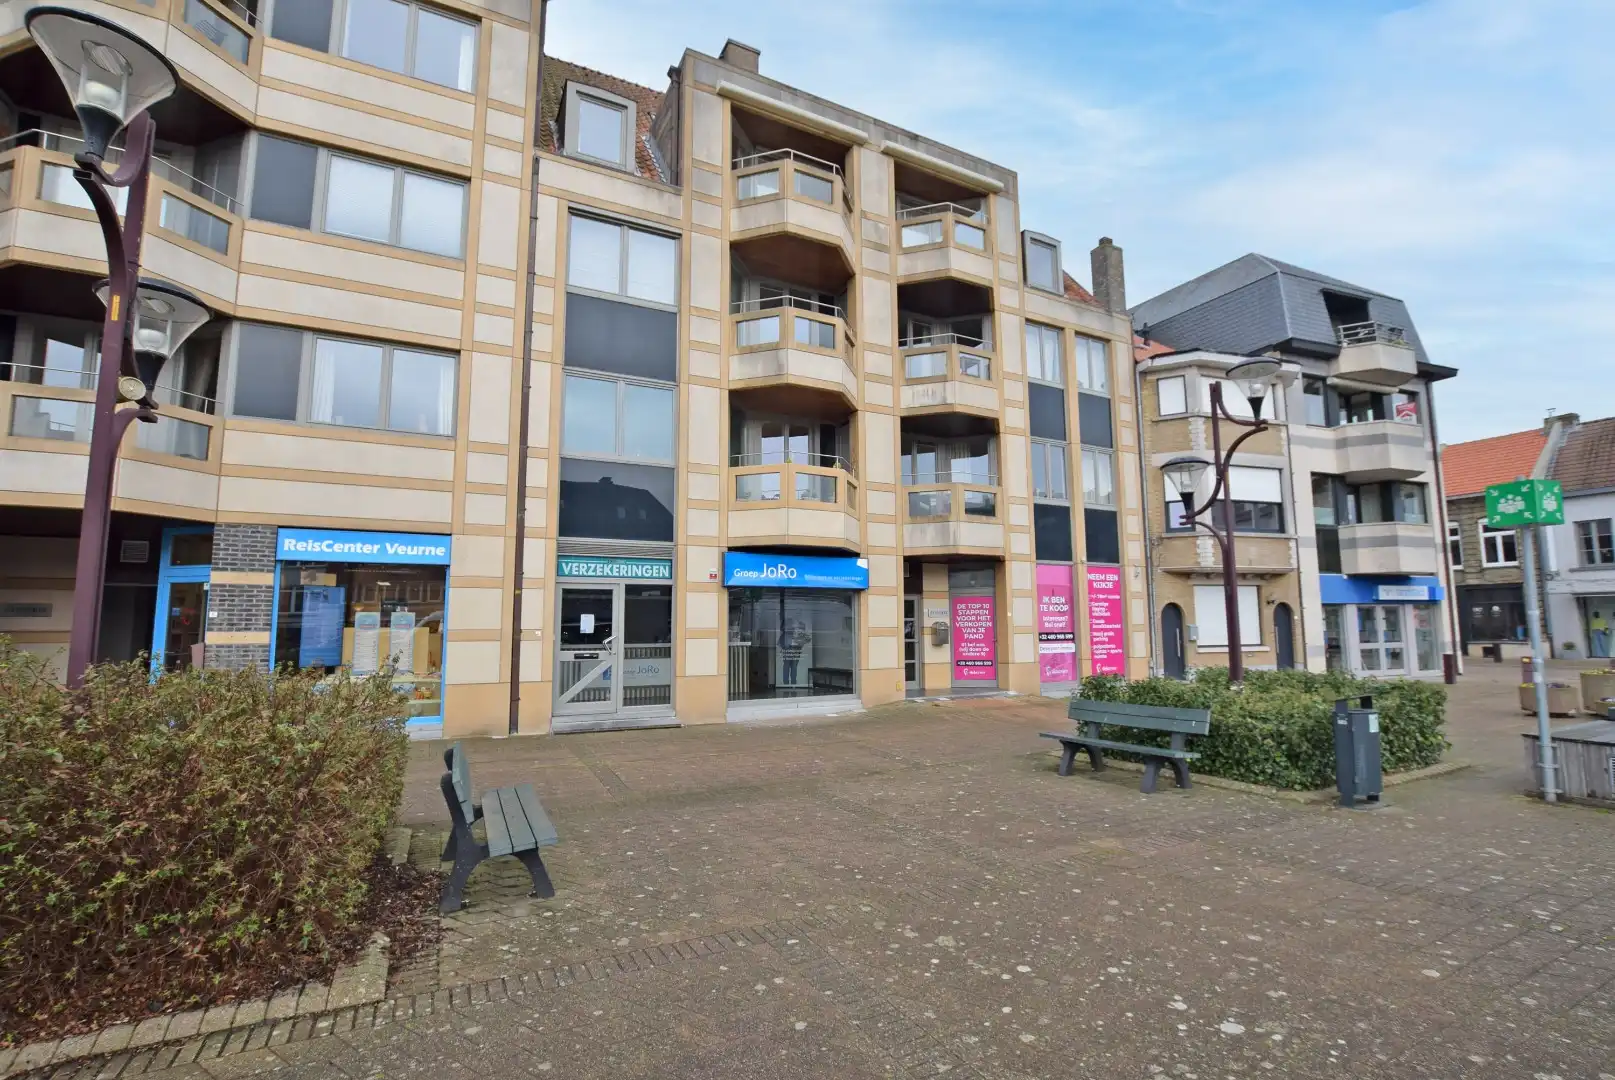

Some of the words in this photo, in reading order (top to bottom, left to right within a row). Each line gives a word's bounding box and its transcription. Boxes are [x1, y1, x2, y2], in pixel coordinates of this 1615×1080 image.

[283, 538, 380, 555] ReisCenter
[384, 542, 446, 556] Veurne
[561, 562, 669, 577] VERZEKERINGEN
[734, 568, 759, 579] Groep
[759, 563, 797, 579] JoRo
[1051, 596, 1066, 604] BEN
[637, 665, 660, 674] JoRo
